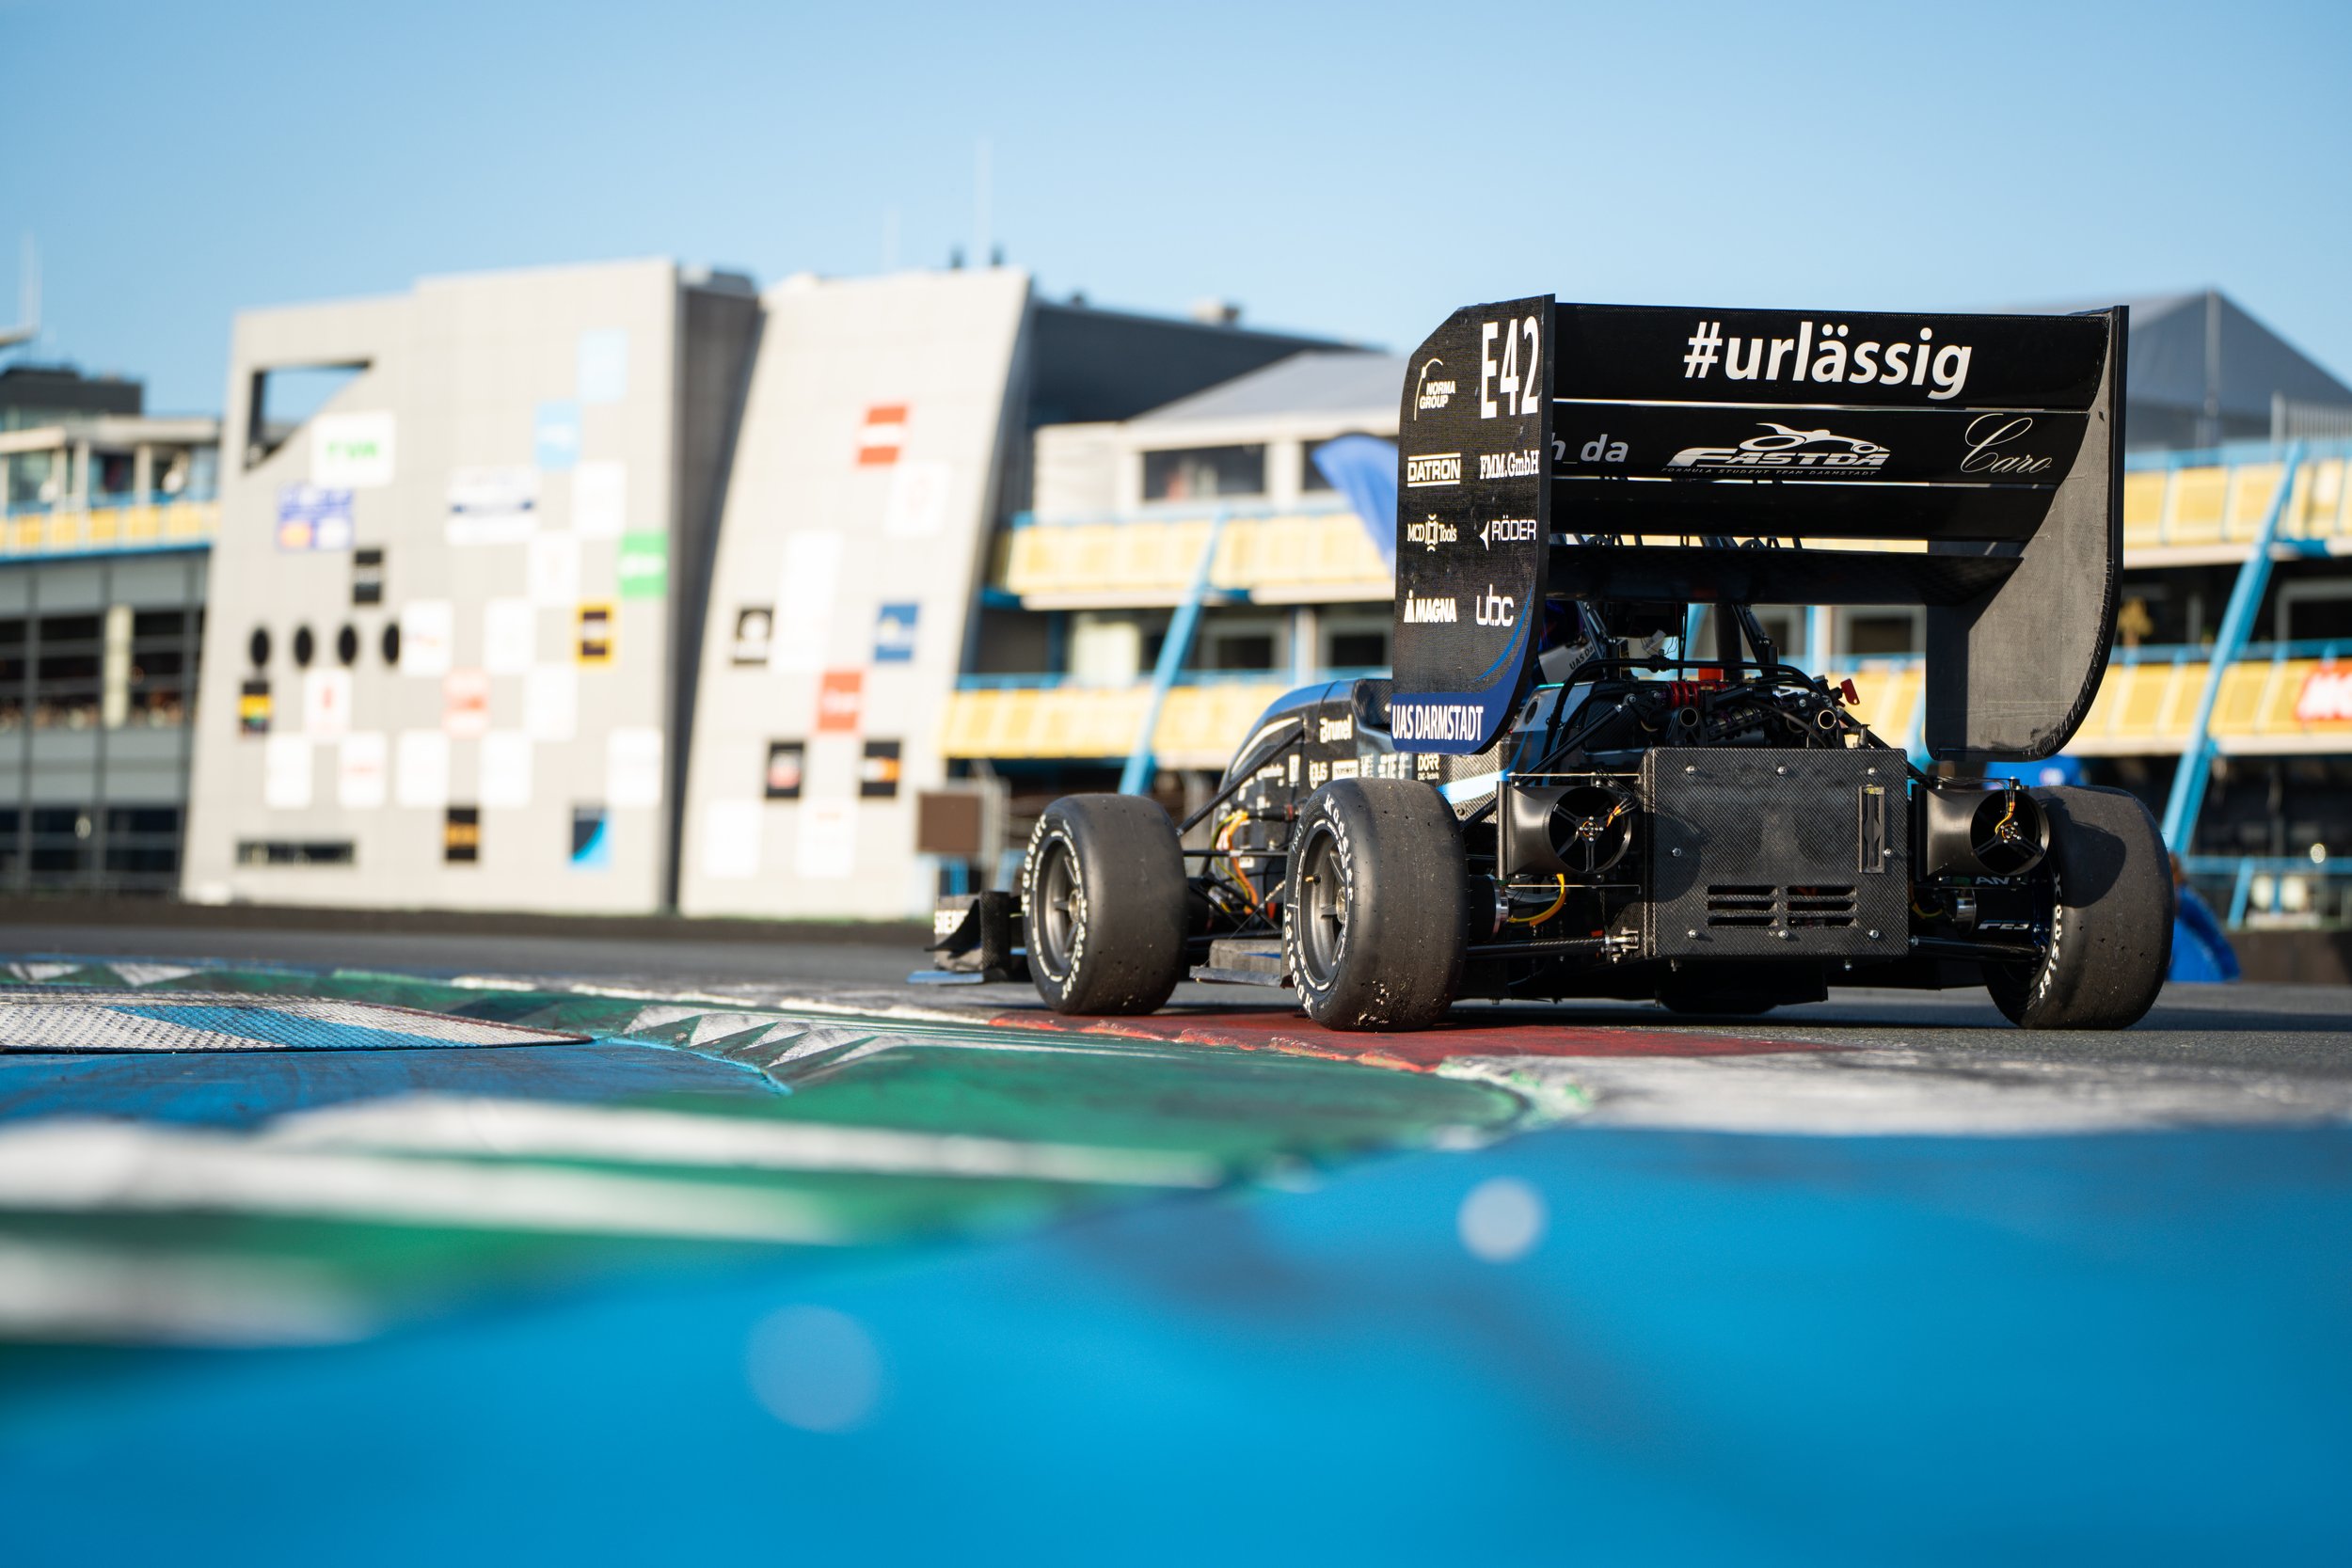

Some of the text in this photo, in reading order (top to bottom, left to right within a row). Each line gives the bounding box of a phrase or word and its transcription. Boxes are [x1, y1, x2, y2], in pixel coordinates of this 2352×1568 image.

[1480, 315, 1540, 420] E42
[1683, 321, 1973, 401] #urlässig
[1425, 380, 1456, 395] NORMA
[1419, 394, 1449, 410] GROUP
[1960, 413, 2054, 474] Caro
[1406, 458, 1461, 483] DATRON
[1406, 523, 1457, 543] MCD Tools
[1491, 515, 1537, 542] RÖDER
[1415, 597, 1457, 624] MAGNA
[1475, 583, 1515, 627] ubc
[1319, 713, 1353, 743] Brunel
[1391, 704, 1485, 741] UAS DARMSTADT
